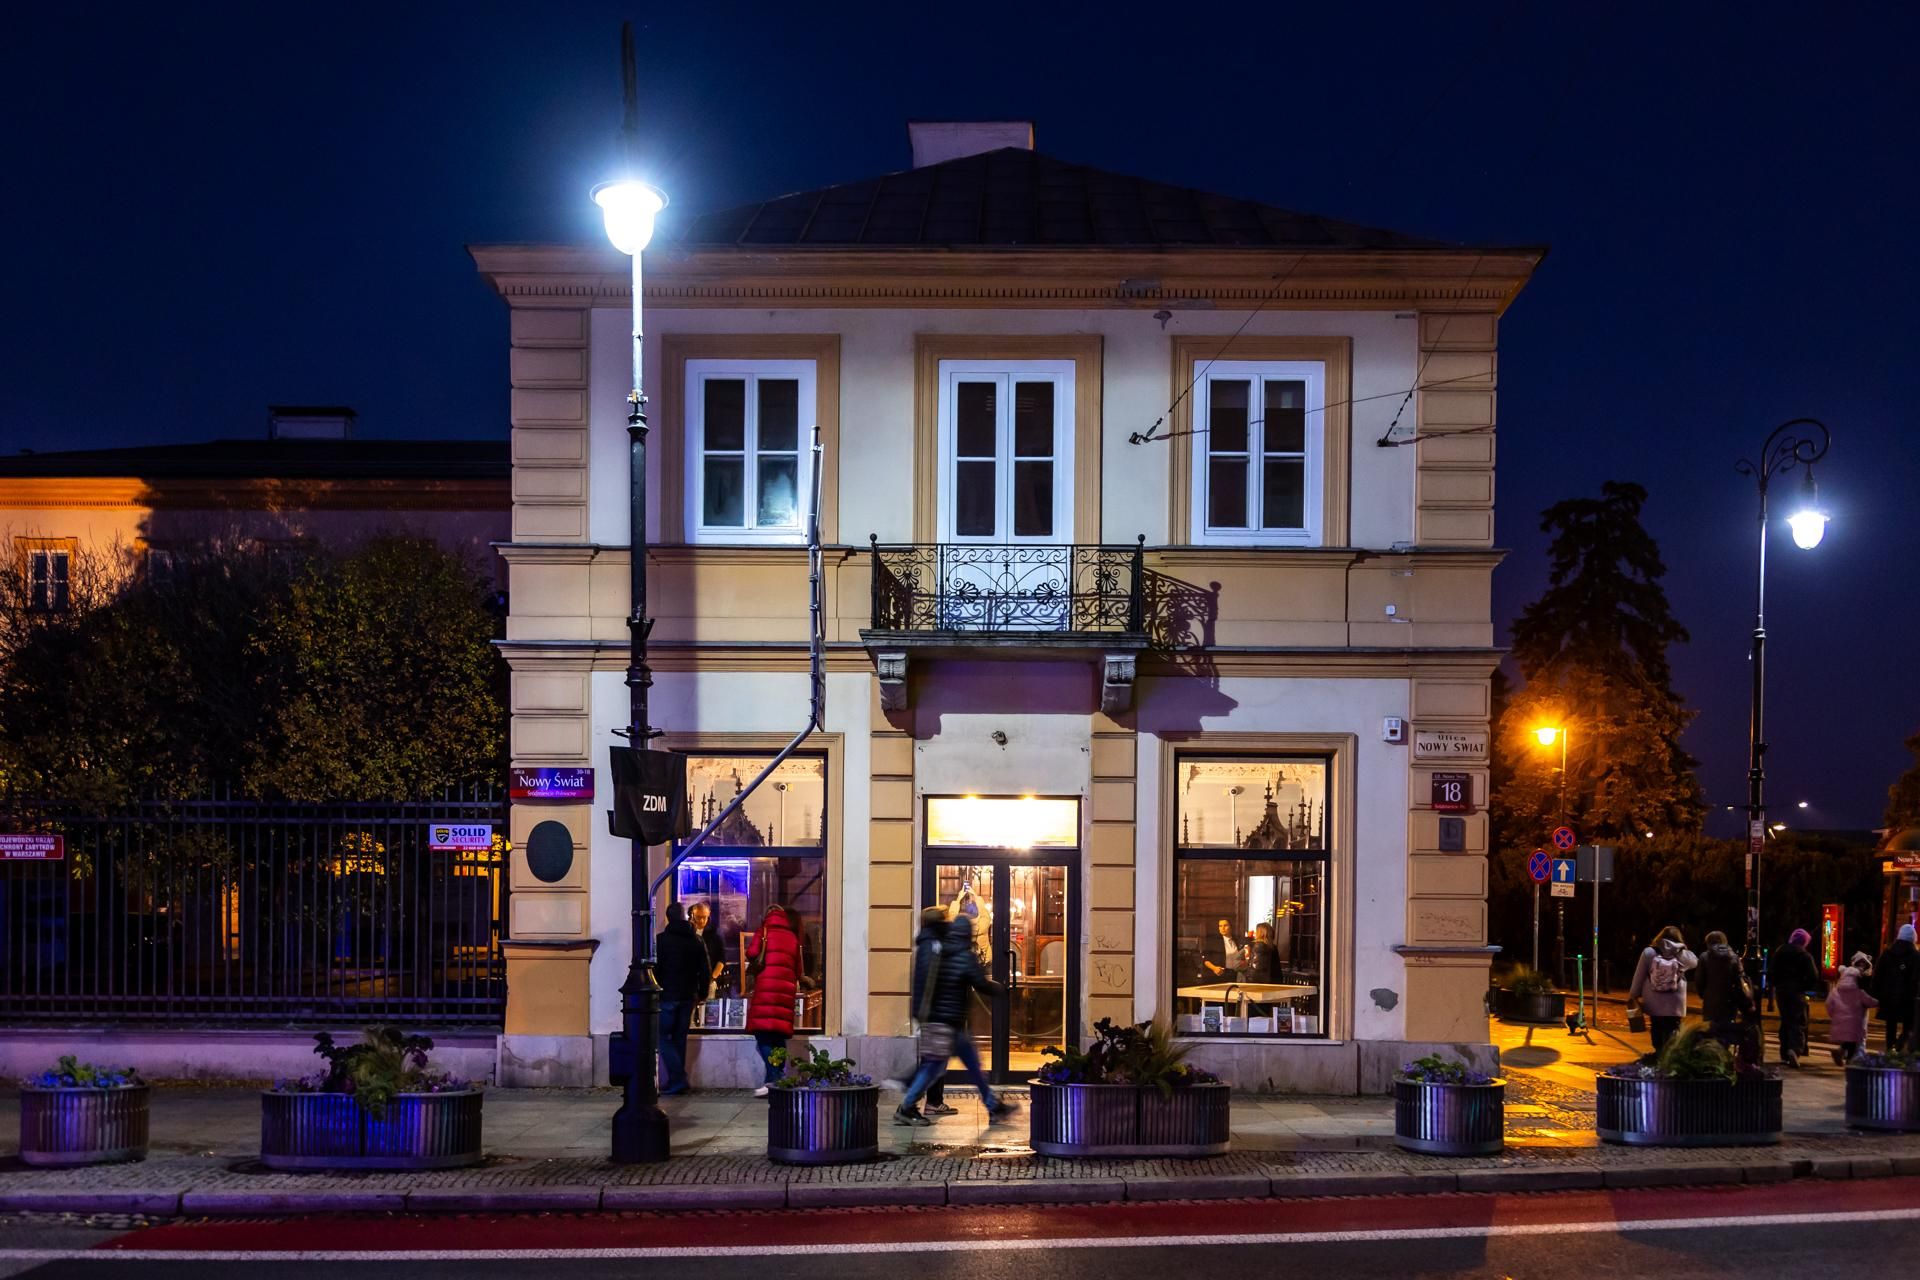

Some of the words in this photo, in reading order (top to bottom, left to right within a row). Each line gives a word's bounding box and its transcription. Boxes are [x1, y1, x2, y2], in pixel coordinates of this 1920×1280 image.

[1418, 743, 1448, 751] NOWY
[519, 775, 552, 791] Nowy
[554, 772, 584, 787] Świat
[1441, 782, 1461, 802] 18
[643, 794, 667, 812] ZDM
[451, 828, 486, 837] SOLID
